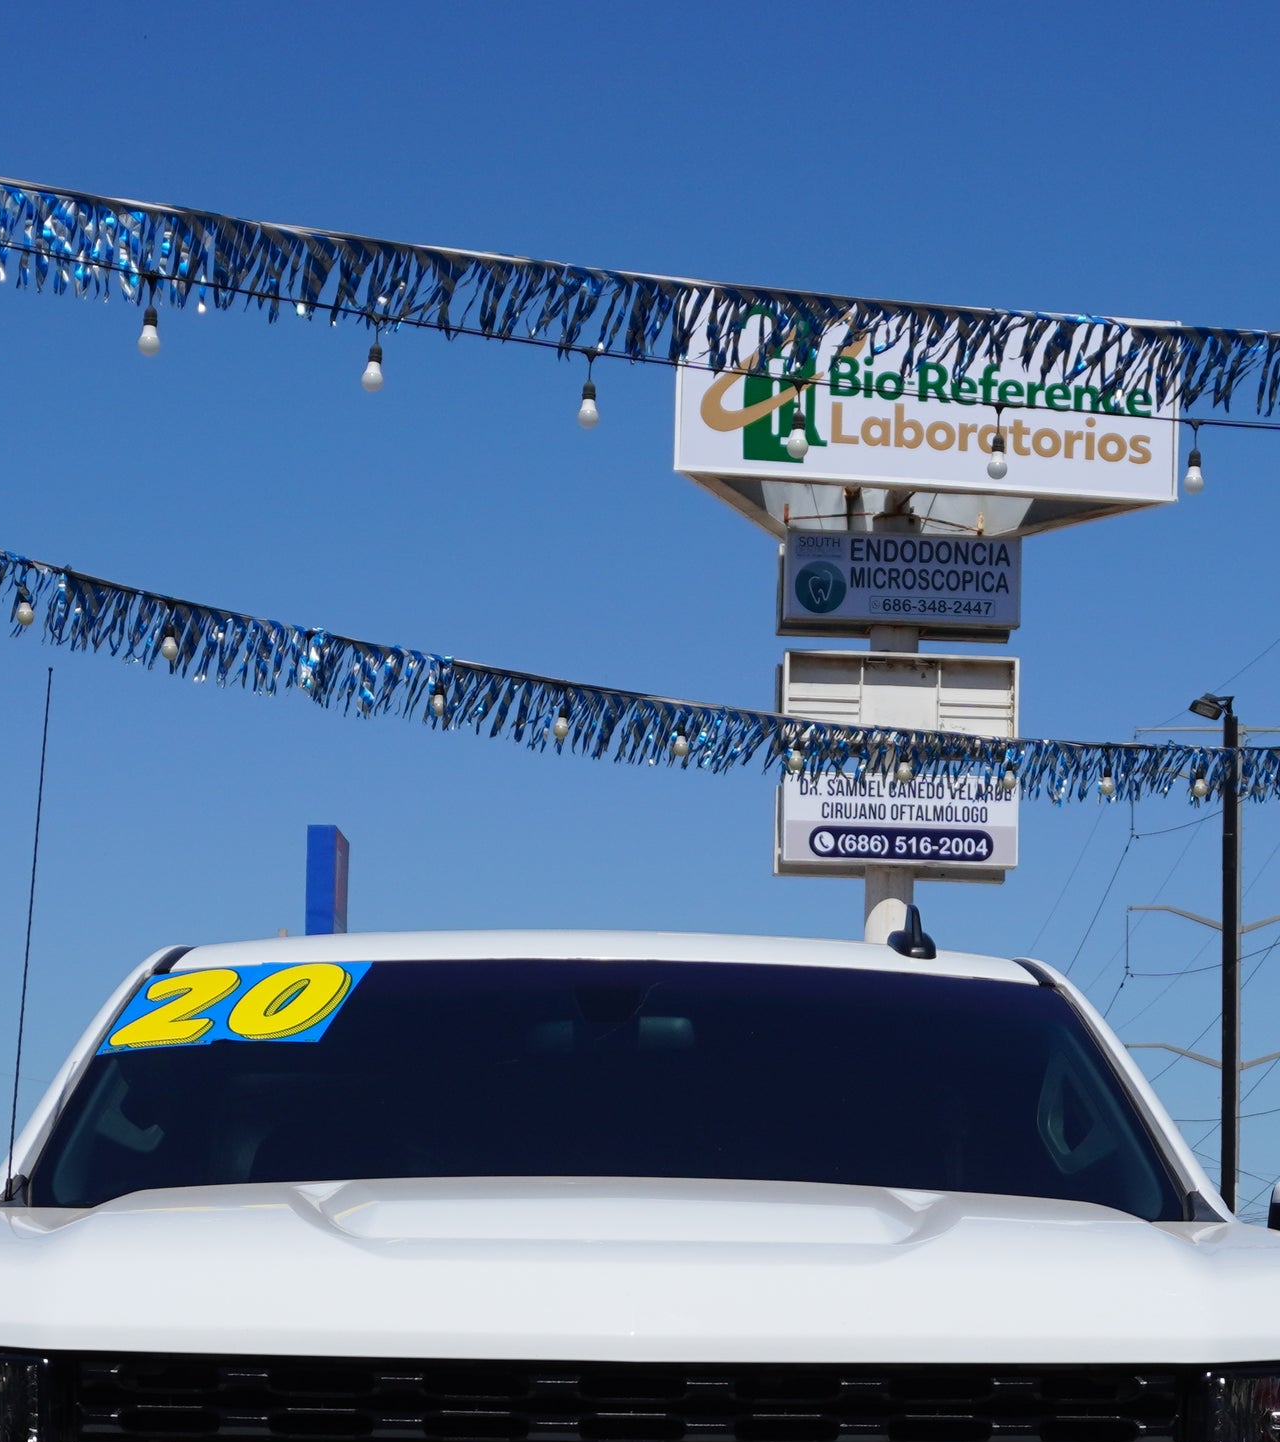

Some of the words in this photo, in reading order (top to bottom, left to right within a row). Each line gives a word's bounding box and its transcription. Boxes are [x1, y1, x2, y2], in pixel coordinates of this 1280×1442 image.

[830, 355, 1152, 417] Bio-Reference
[831, 401, 1153, 464] Laboratorios
[798, 536, 841, 548] SOUTH
[850, 538, 1011, 567] ENDODONCIA
[850, 566, 1010, 593] MICROSCOPICA
[882, 598, 993, 615] 686-348-2447
[827, 778, 885, 798] SAMUEL
[821, 802, 886, 820] CIRUJANO
[890, 802, 988, 823] OFTALMÓLOGO
[838, 833, 890, 855] (686)
[895, 836, 988, 857] 516-2004
[109, 963, 353, 1048] 20
